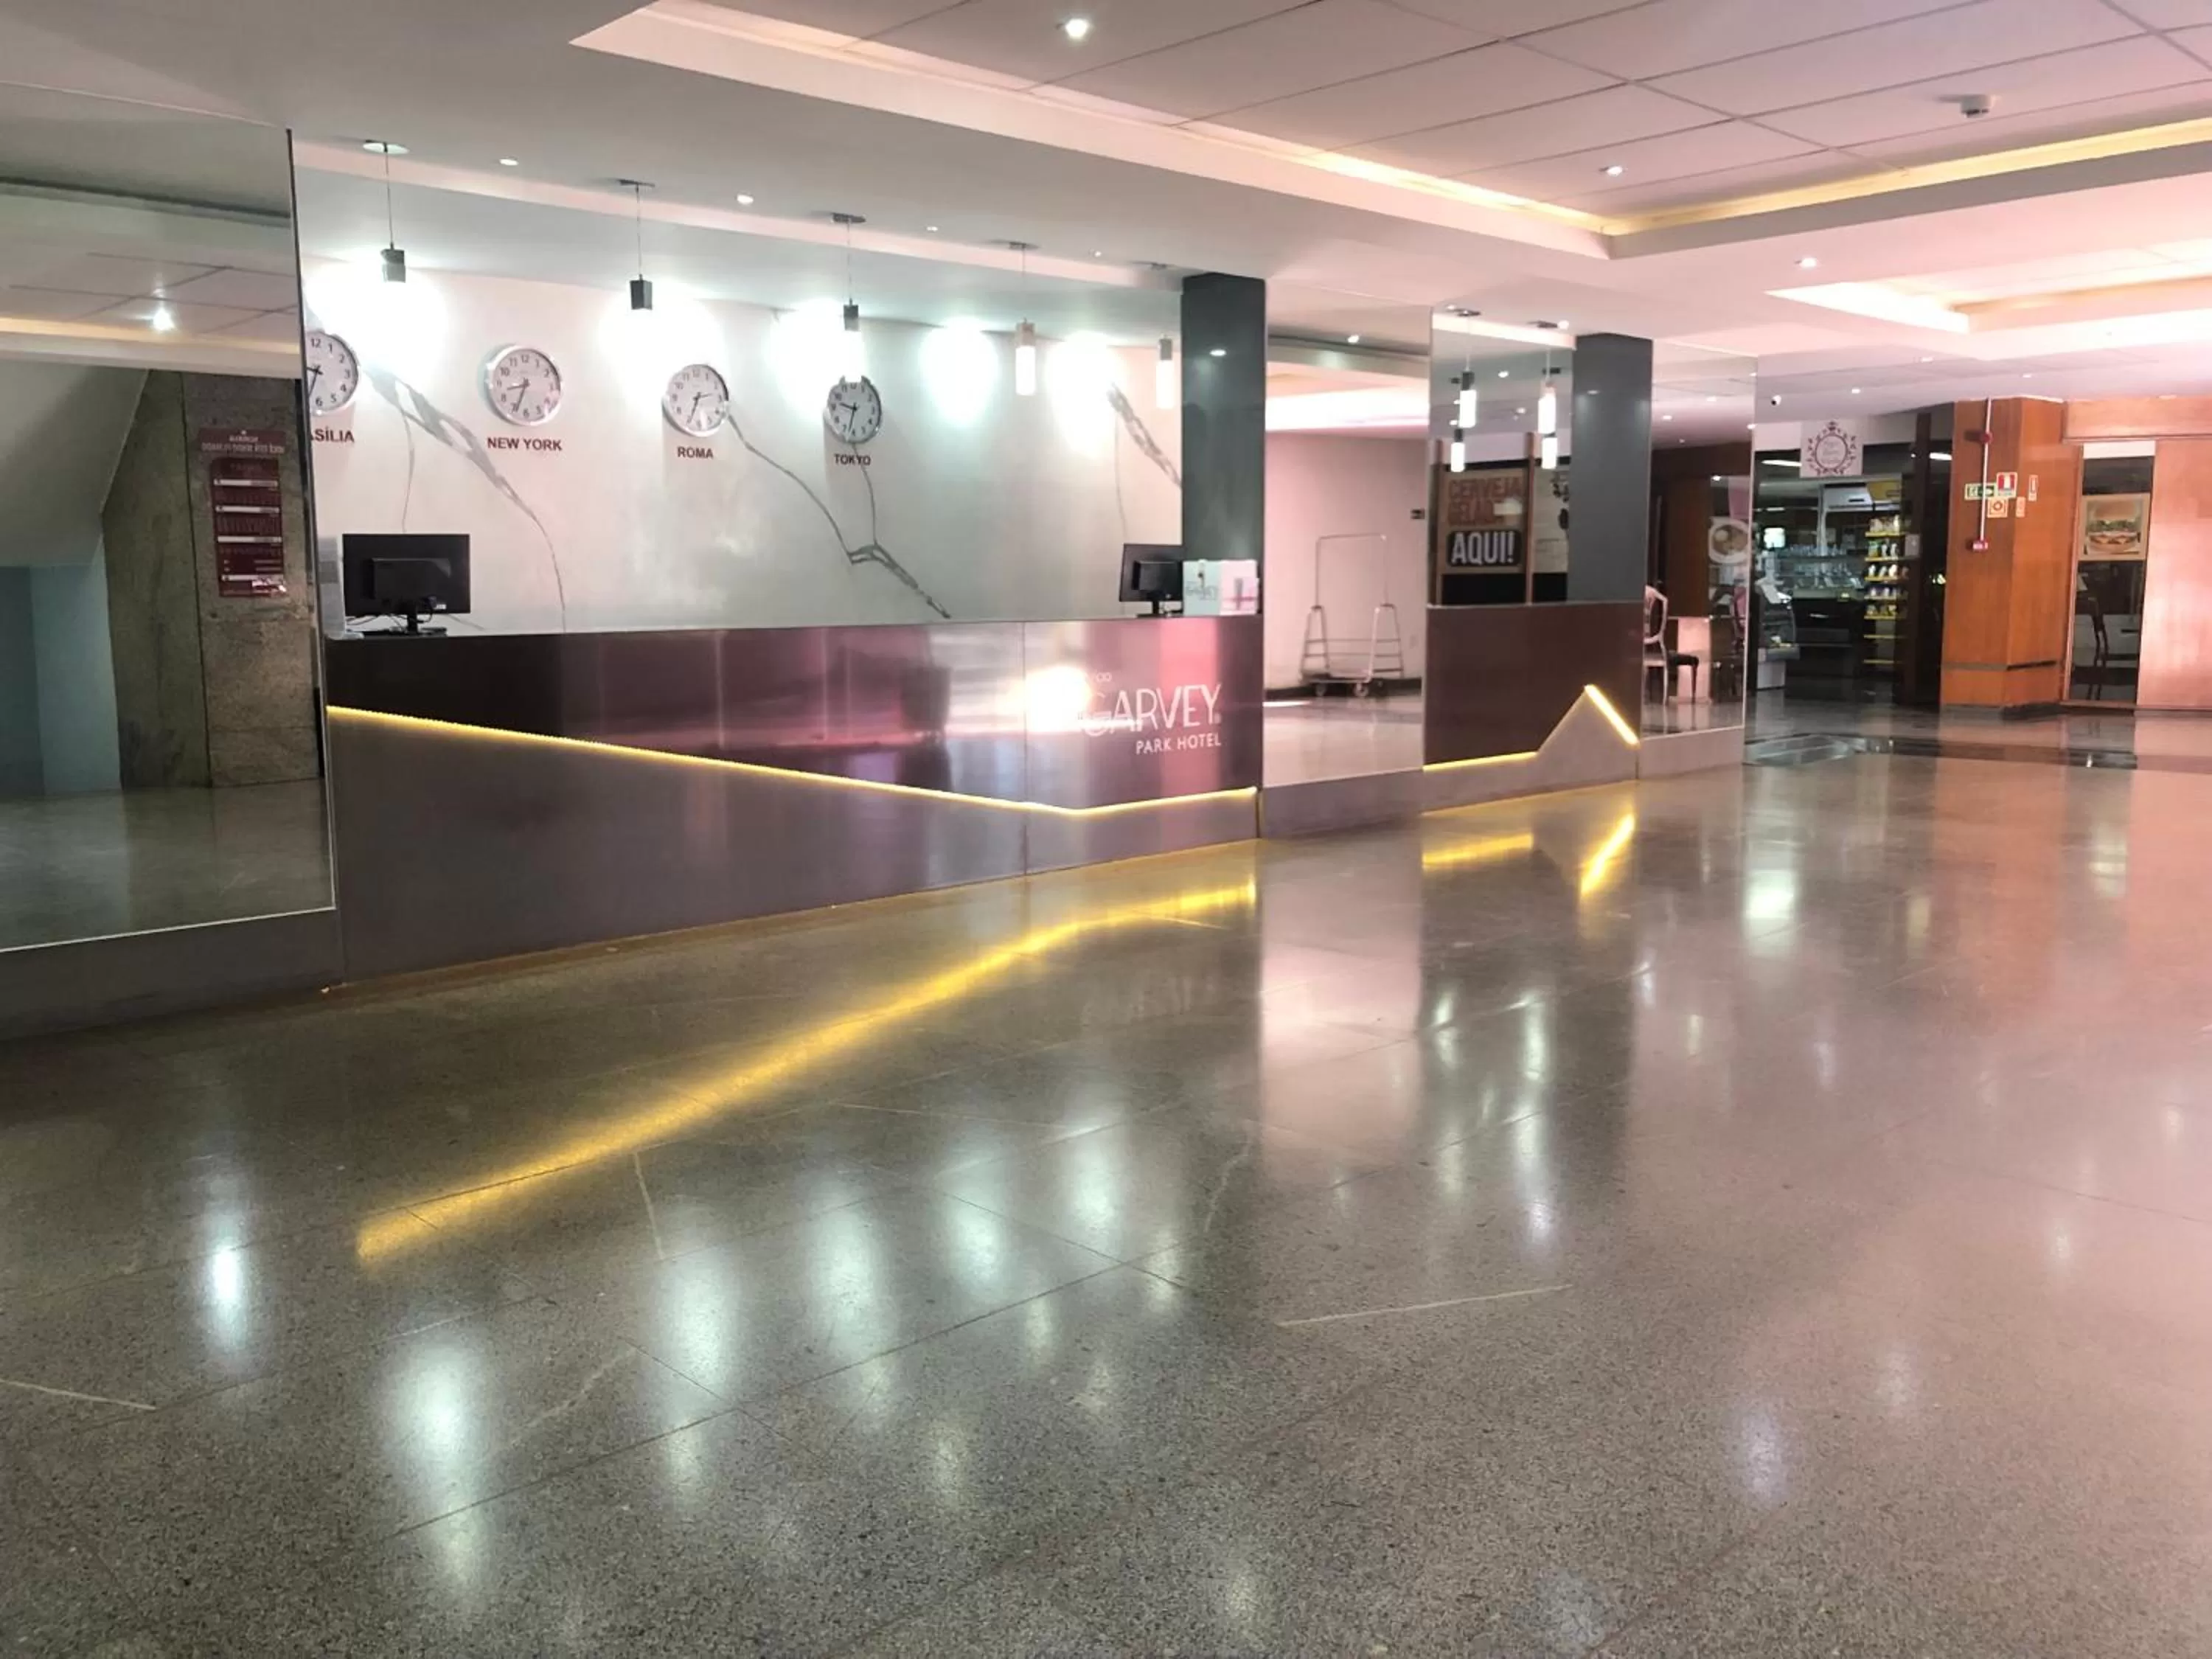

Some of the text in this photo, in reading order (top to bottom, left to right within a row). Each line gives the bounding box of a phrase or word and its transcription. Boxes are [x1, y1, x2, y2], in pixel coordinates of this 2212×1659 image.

[487, 437, 563, 451] NEW YORK
[677, 445, 714, 459] ROMA
[834, 453, 872, 466] TOKYO
[1450, 530, 1515, 565] AQUI!
[1135, 734, 1222, 755] PARK HOTEL
